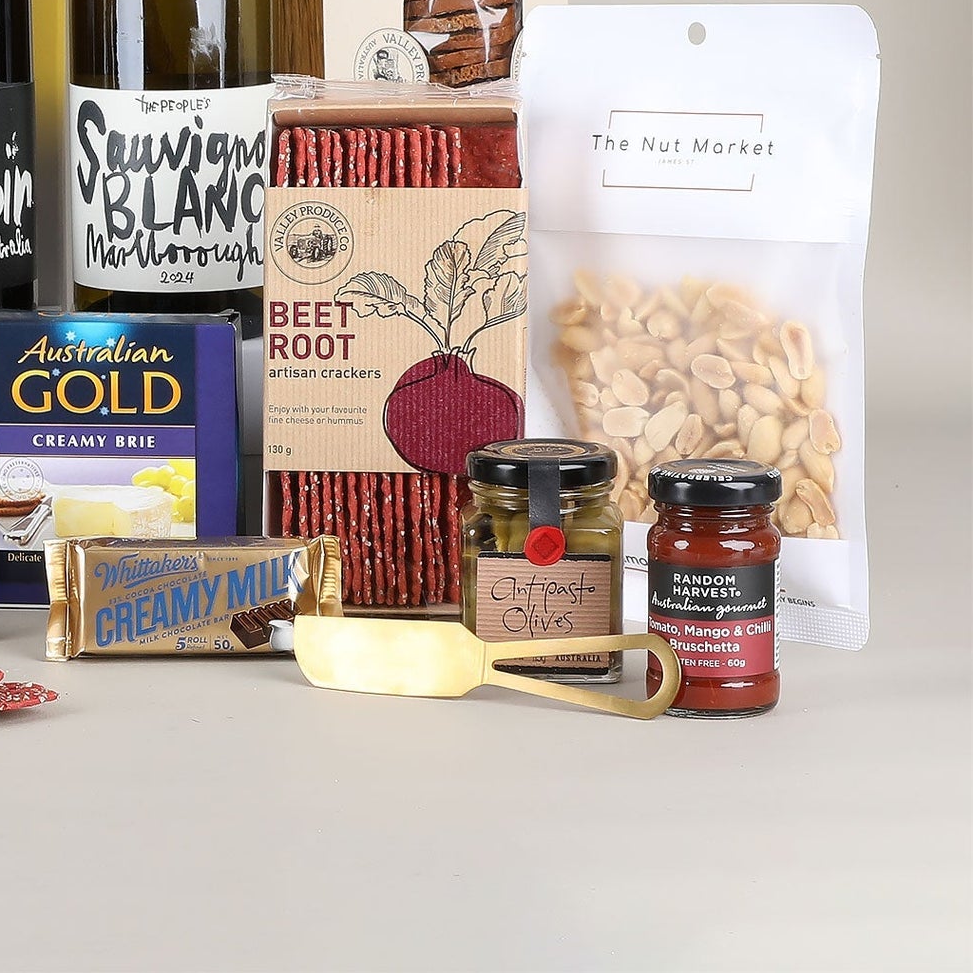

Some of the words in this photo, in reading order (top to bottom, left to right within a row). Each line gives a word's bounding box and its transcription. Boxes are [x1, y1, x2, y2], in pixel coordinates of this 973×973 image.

[382, 33, 421, 61] VALLEY
[160, 97, 211, 114] PEOPLE'S
[77, 100, 266, 204] Sauvigno
[592, 134, 629, 151] The
[641, 136, 680, 153] Nut
[693, 138, 775, 156] Market
[274, 210, 298, 252] VALLEY
[299, 206, 347, 235] PRODUCE
[160, 271, 194, 284] 2024
[269, 300, 353, 328] BEET
[18, 334, 174, 364] Australian
[269, 334, 355, 360] ROOT
[268, 367, 317, 379] artisan
[320, 366, 382, 379] crackers
[11, 369, 182, 415] GOLD
[268, 405, 290, 415] Enjoy
[292, 405, 309, 414] with
[310, 407, 330, 415] your
[331, 405, 367, 414] favourite
[268, 416, 284, 424] fine
[285, 416, 315, 425] cheese
[316, 417, 326, 425] or
[327, 416, 364, 425] hummus
[32, 434, 107, 448] CREAMY
[115, 435, 156, 448] BRIE
[267, 445, 284, 454] 130
[7, 552, 42, 563] Delicate
[94, 551, 199, 591] Whittaker's
[673, 573, 735, 585] RANDOM
[126, 588, 154, 600] COCOA
[158, 571, 207, 590] CHOCOLATE
[491, 572, 595, 613] Antipasto
[96, 574, 222, 647] CREAMY
[227, 551, 303, 610] MILK
[651, 591, 715, 612] Australian
[716, 597, 767, 620] gourmet
[787, 596, 816, 607] BEGINS
[139, 634, 159, 645] MILK
[162, 620, 211, 638] CHOCOLATE
[214, 615, 229, 623] BAR
[503, 604, 575, 637] Olives
[684, 624, 730, 638] Mango
[734, 625, 743, 635] &
[746, 620, 771, 635] Chilli
[176, 637, 186, 651] 5
[669, 638, 740, 652] Bruschetta
[554, 654, 602, 662] AUSTRALIA
[698, 659, 719, 667] FREE
[728, 658, 745, 668] 60g
